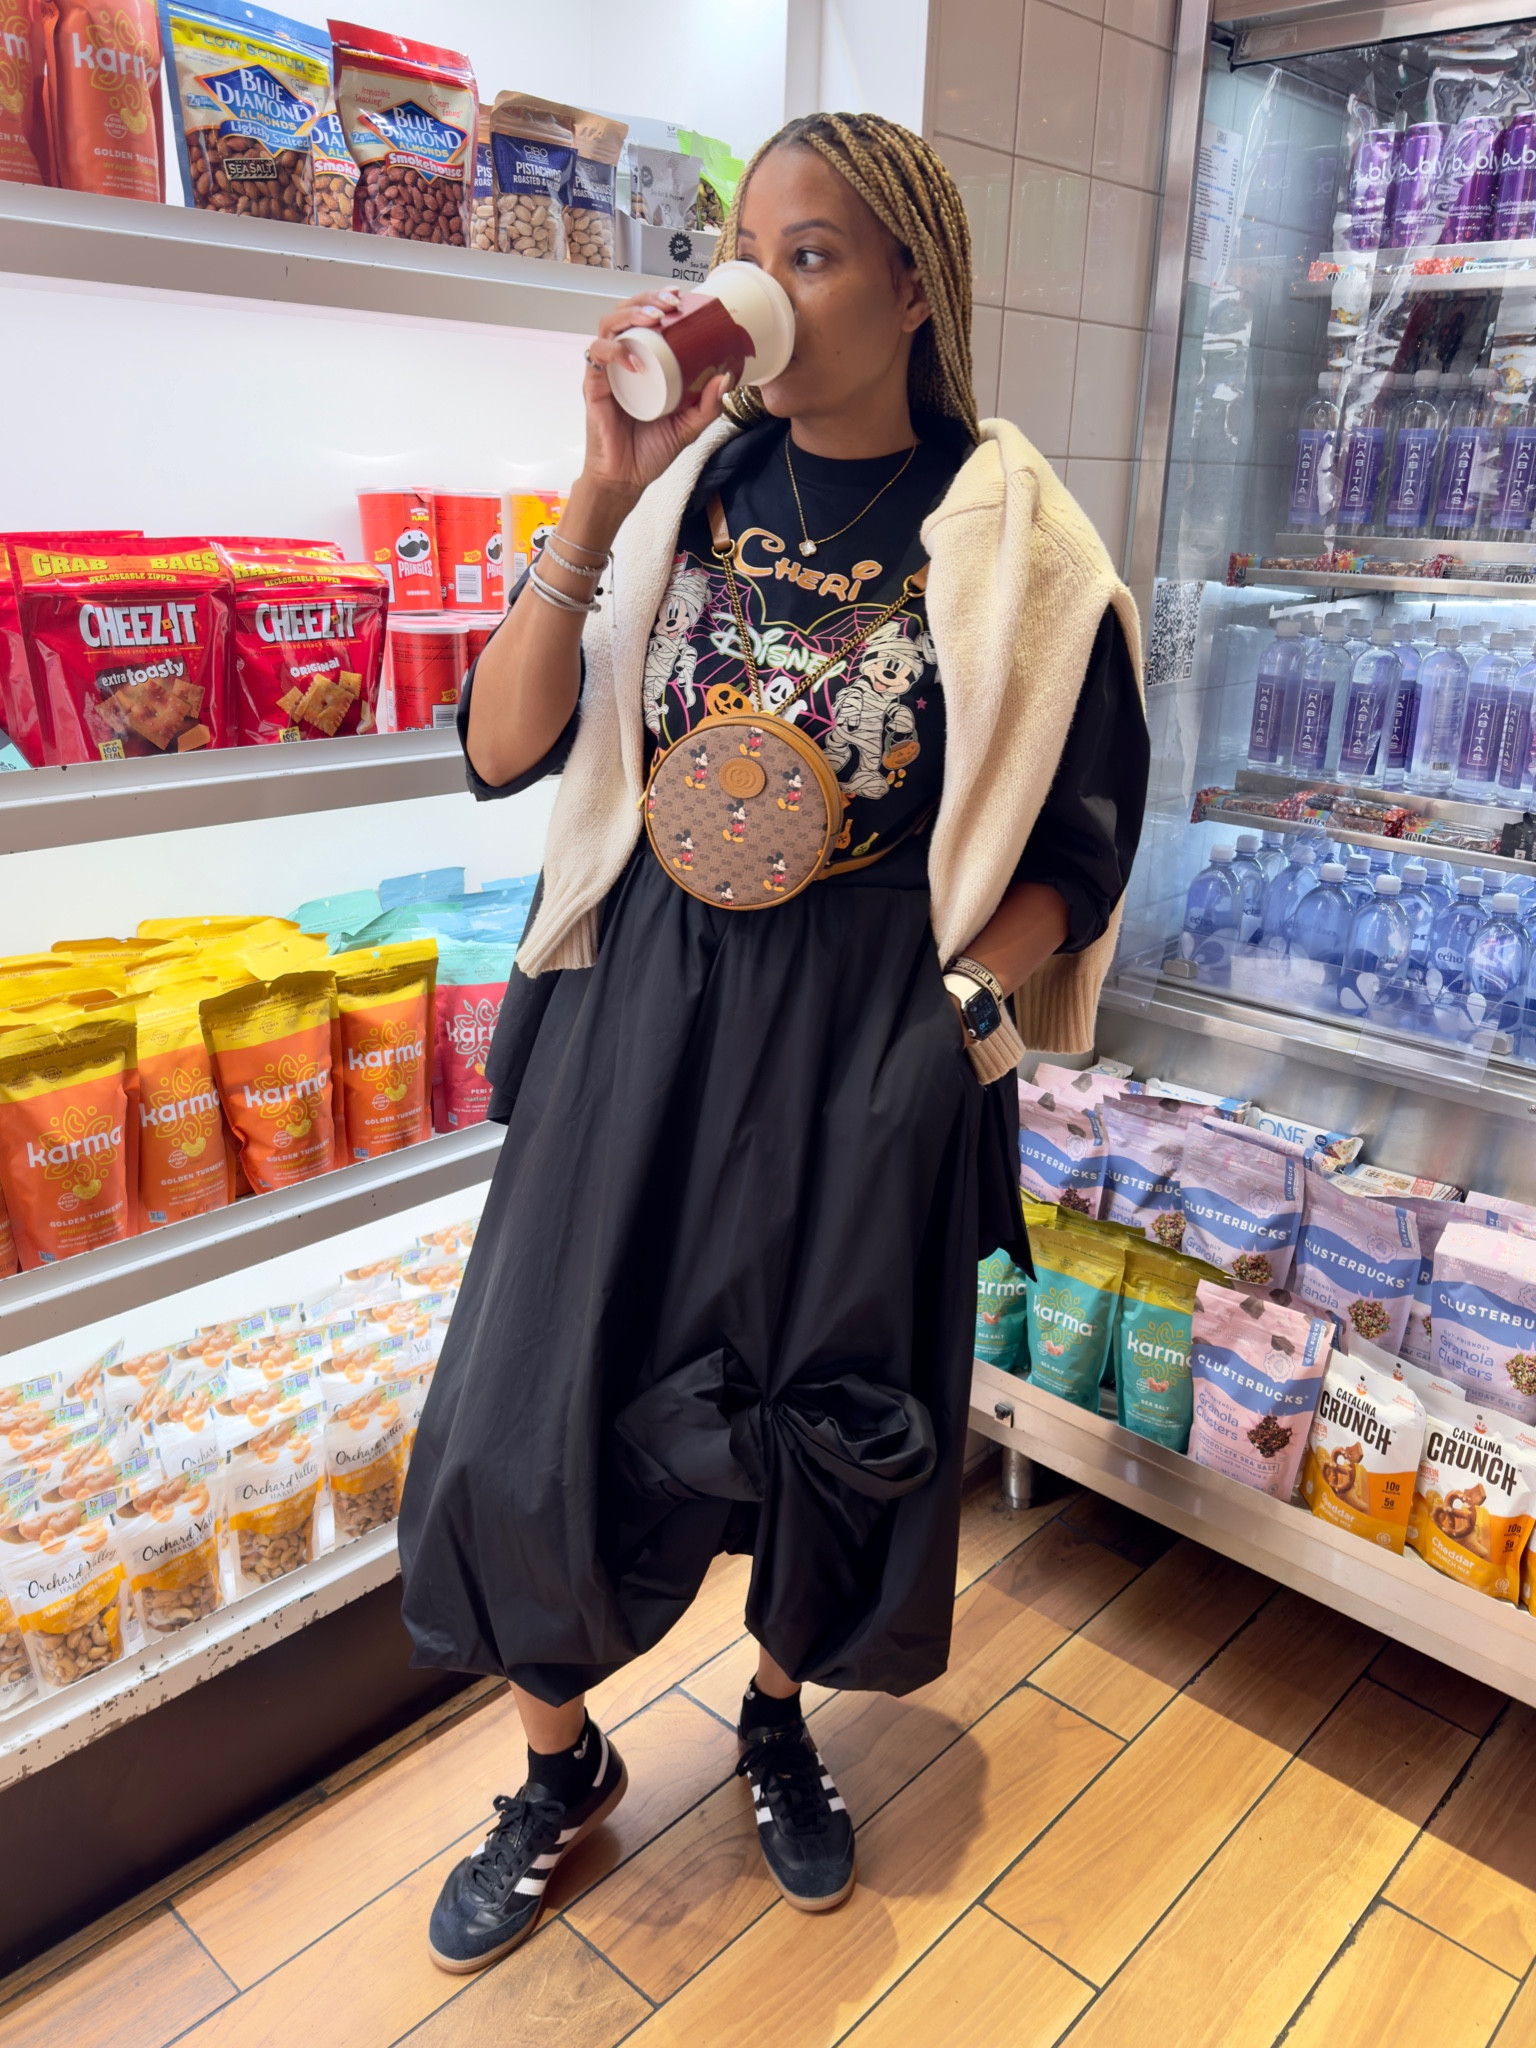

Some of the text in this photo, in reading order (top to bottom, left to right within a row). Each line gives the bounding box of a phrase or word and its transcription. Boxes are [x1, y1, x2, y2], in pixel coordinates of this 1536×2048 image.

[72, 33, 157, 91] karm
[202, 31, 241, 52] LOW
[246, 43, 305, 72] SODIUM
[239, 69, 284, 103] BLUE
[215, 81, 312, 121] DIAMOND
[239, 109, 297, 130] ALMONDS
[393, 107, 437, 132] BLUE
[230, 121, 310, 148] Lightly Salted
[380, 121, 462, 149] DIAMOND
[94, 147, 132, 161] GOLDEN
[400, 141, 448, 157] ALMONDS
[523, 145, 548, 158] CIBO
[1452, 150, 1499, 175] bubly
[1501, 144, 1536, 167] bub
[228, 163, 274, 175] SEA SALT
[315, 162, 360, 177] Smoke
[389, 153, 462, 177] Smokehouse
[1398, 154, 1449, 180] bubly
[475, 177, 492, 187] ROAST
[513, 175, 540, 186] ROASTED
[672, 268, 705, 283] PISTA
[1298, 444, 1313, 502] HABITAS
[1350, 441, 1367, 502] HABITAS
[1403, 442, 1421, 505] HABITAS
[1451, 442, 1472, 505] HABITAS
[1510, 442, 1532, 506] HABITAS
[32, 551, 221, 577] GRAB BAGS
[89, 572, 177, 583] RECLOSEABLE ZIPPER
[231, 563, 282, 579] RAB
[397, 559, 433, 578] PRINGLES
[487, 563, 502, 580] PRIN
[265, 575, 341, 587] RECLOSEABLE ZIPPER
[101, 658, 184, 687] extra toasty
[1256, 687, 1271, 743] HABITAS
[1302, 693, 1318, 749] HABITAS
[1352, 698, 1370, 754] HABITAS
[1472, 703, 1491, 761] HABITAS
[1503, 709, 1517, 767] HABITAS
[1402, 831, 1428, 843] KIND
[1437, 951, 1463, 965] echo
[446, 1020, 494, 1043] kar
[348, 1040, 424, 1071] karma
[243, 1070, 328, 1108] karma
[140, 1089, 220, 1128] karma
[365, 1107, 423, 1125] GOLDEN TURMERIC
[1258, 1118, 1307, 1145] ONE
[27, 1124, 122, 1168] karma
[266, 1151, 298, 1163] GOLDEN
[161, 1160, 225, 1186] GOLDEN TURMERIC
[1020, 1145, 1097, 1180] LUSTERBUCKS
[1020, 1183, 1047, 1201] anola
[1105, 1169, 1181, 1198] LUSTERBUC
[50, 1216, 86, 1228] GOLDEN
[1185, 1199, 1288, 1242] CLUSTERBUCKS
[1186, 1236, 1224, 1267] Granola
[1305, 1237, 1406, 1289] CLUSTERBUCKS
[977, 1280, 1027, 1297] arma
[1303, 1284, 1340, 1309] ranola
[1033, 1295, 1093, 1337] karma
[1440, 1293, 1535, 1330] CLUSTERBU
[991, 1333, 1005, 1341] SALT
[1438, 1346, 1493, 1383] Clusters
[1440, 1335, 1494, 1368] Granola
[1040, 1360, 1064, 1375] SEA SALT
[1198, 1354, 1304, 1406] CLUSTERBUCKS
[1140, 1399, 1170, 1412] SEA SALT
[1198, 1393, 1239, 1428] Granola
[1336, 1387, 1377, 1418] CATALINA
[1196, 1405, 1239, 1441] Clusters
[1319, 1390, 1393, 1456] CRUNCH
[1199, 1432, 1277, 1472] CHOCOLATE SEA SALT
[1452, 1426, 1502, 1457] CATALINA
[182, 1445, 218, 1470] Orchar
[1427, 1431, 1518, 1496] CRUNCH
[243, 1473, 293, 1500] Orchard
[1385, 1481, 1400, 1492] 10g
[1384, 1497, 1395, 1508] 5g
[142, 1512, 214, 1561] Orchard Vall
[1507, 1523, 1522, 1534] 10g
[1431, 1535, 1476, 1569] Cheddar
[1504, 1541, 1515, 1551] 5g
[28, 1549, 117, 1599] Orchard Valley
[1457, 1565, 1470, 1577] MIX
[42, 1597, 77, 1620] JUMBO
